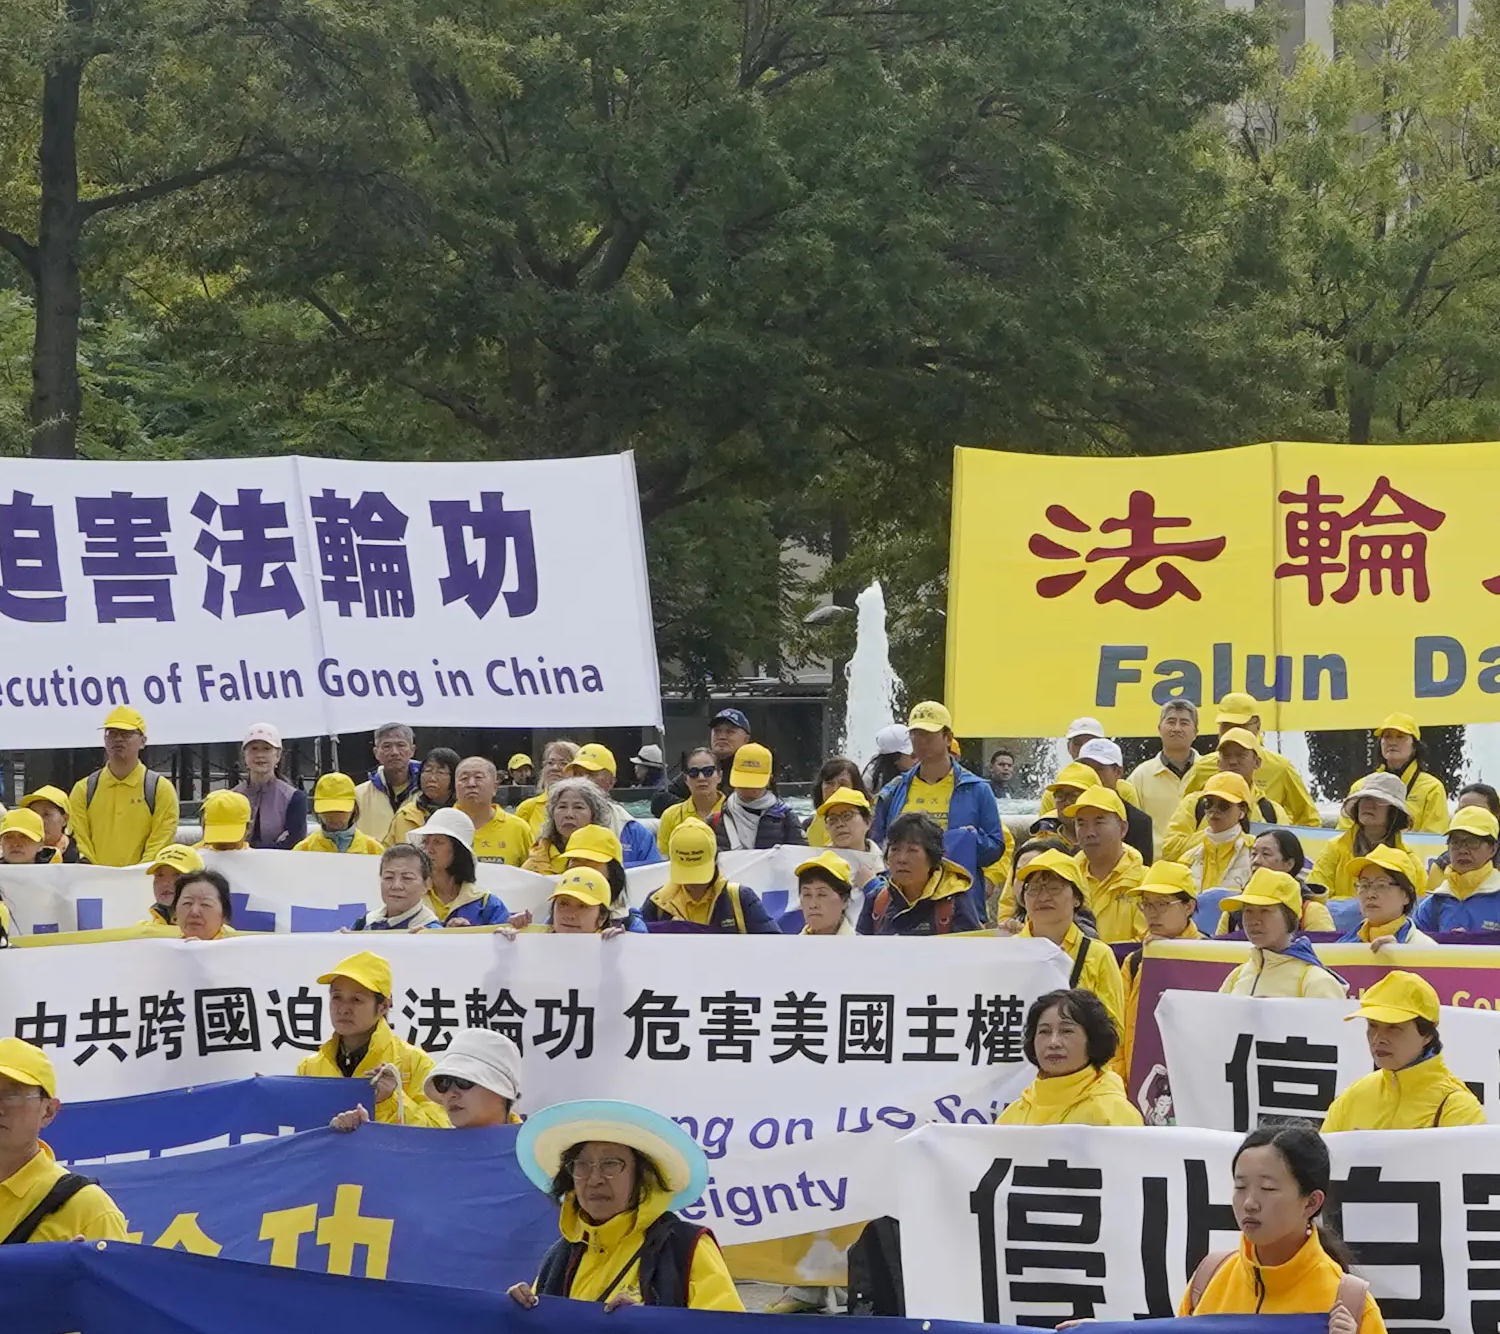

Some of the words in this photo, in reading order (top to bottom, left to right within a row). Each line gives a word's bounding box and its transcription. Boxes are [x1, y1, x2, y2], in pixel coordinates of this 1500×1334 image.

[143, 662, 182, 705] of
[196, 659, 304, 702] Falun
[317, 658, 424, 707] Gong
[435, 659, 474, 697] in
[486, 655, 604, 697] China
[1097, 643, 1348, 707] Falun
[14, 987, 595, 1065] 中共跨國迫法輪功
[623, 989, 1026, 1065] 危害美國主權
